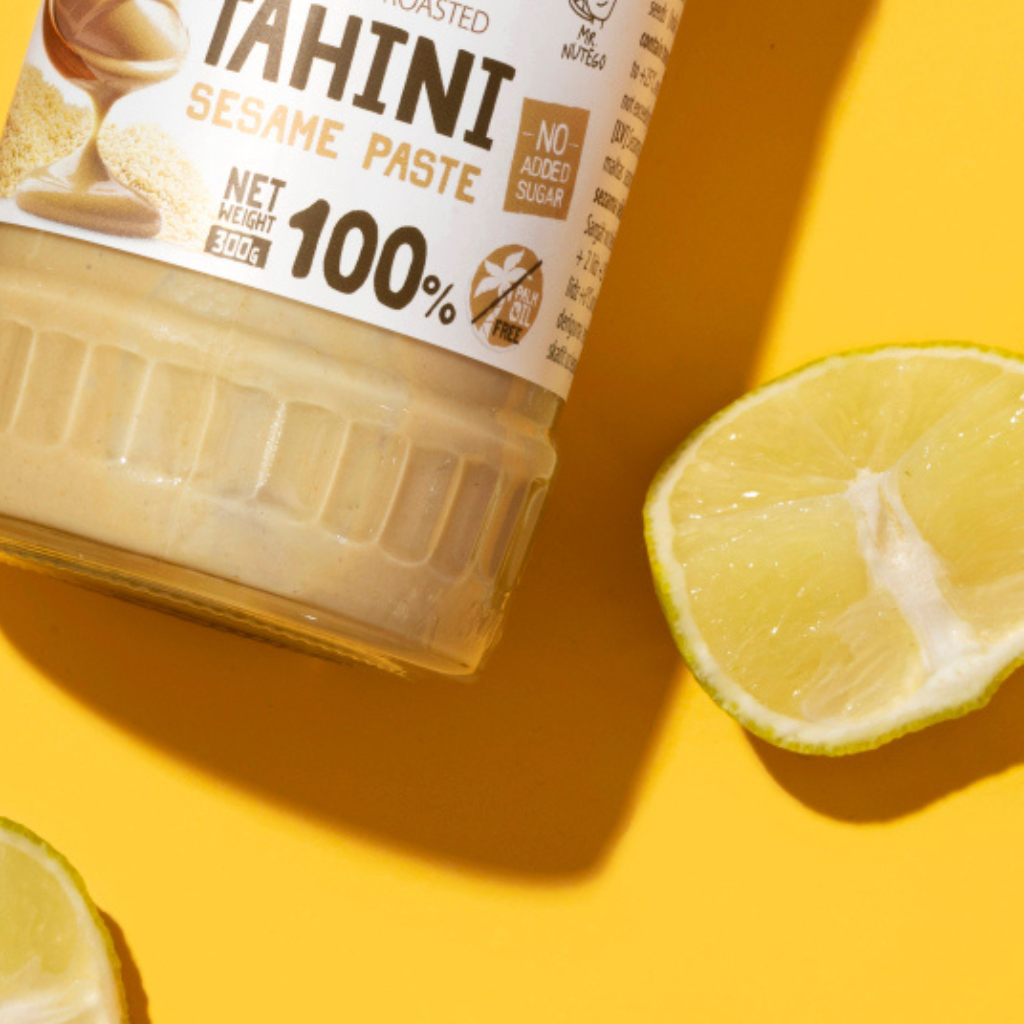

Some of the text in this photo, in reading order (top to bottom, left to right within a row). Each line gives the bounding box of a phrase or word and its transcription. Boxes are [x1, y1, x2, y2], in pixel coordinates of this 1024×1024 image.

[186, 81, 482, 205] SESAME PASTE
[535, 119, 570, 156] NO
[520, 156, 572, 184] ADDED
[223, 166, 286, 213] NET
[515, 181, 565, 208] SUGAR
[217, 201, 277, 234] WEIGHT
[289, 198, 456, 325] 100%
[515, 284, 539, 307] PALM
[509, 301, 531, 329] OIL
[492, 318, 523, 345] FREE
